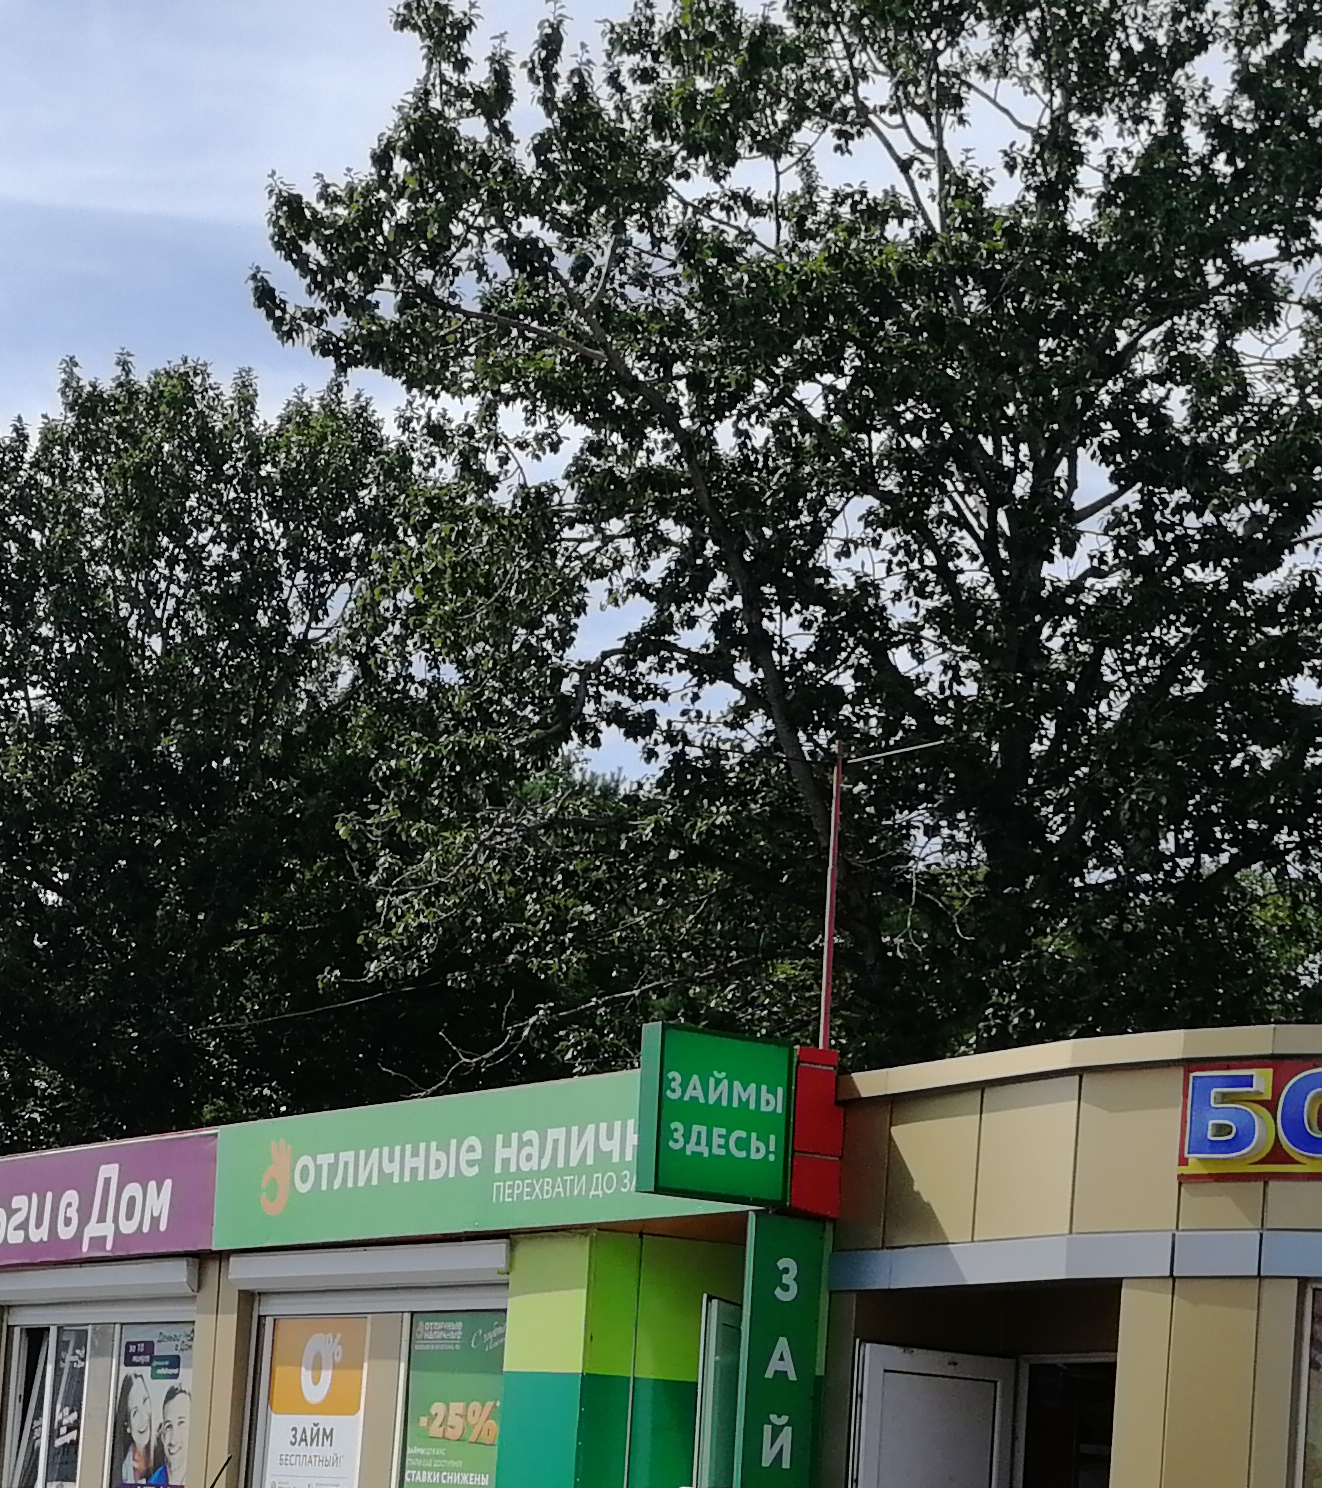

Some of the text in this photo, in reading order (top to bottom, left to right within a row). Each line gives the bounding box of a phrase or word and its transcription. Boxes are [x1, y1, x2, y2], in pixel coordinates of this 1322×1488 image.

[665, 1070, 784, 1114] ЗАЙМЫ
[668, 1121, 776, 1162] ЗДЕСЬ!
[294, 1135, 483, 1194] отличные
[57, 1190, 79, 1239] в
[82, 1163, 173, 1253] Дом
[492, 1173, 586, 1203] ПЕРЕХВАТИ
[589, 1172, 618, 1200] ДО
[300, 1332, 343, 1405] 0%
[289, 1422, 335, 1448] ЗАЙМ
[405, 1470, 489, 1485] СТАВКИ СНИЖЕНЫ
